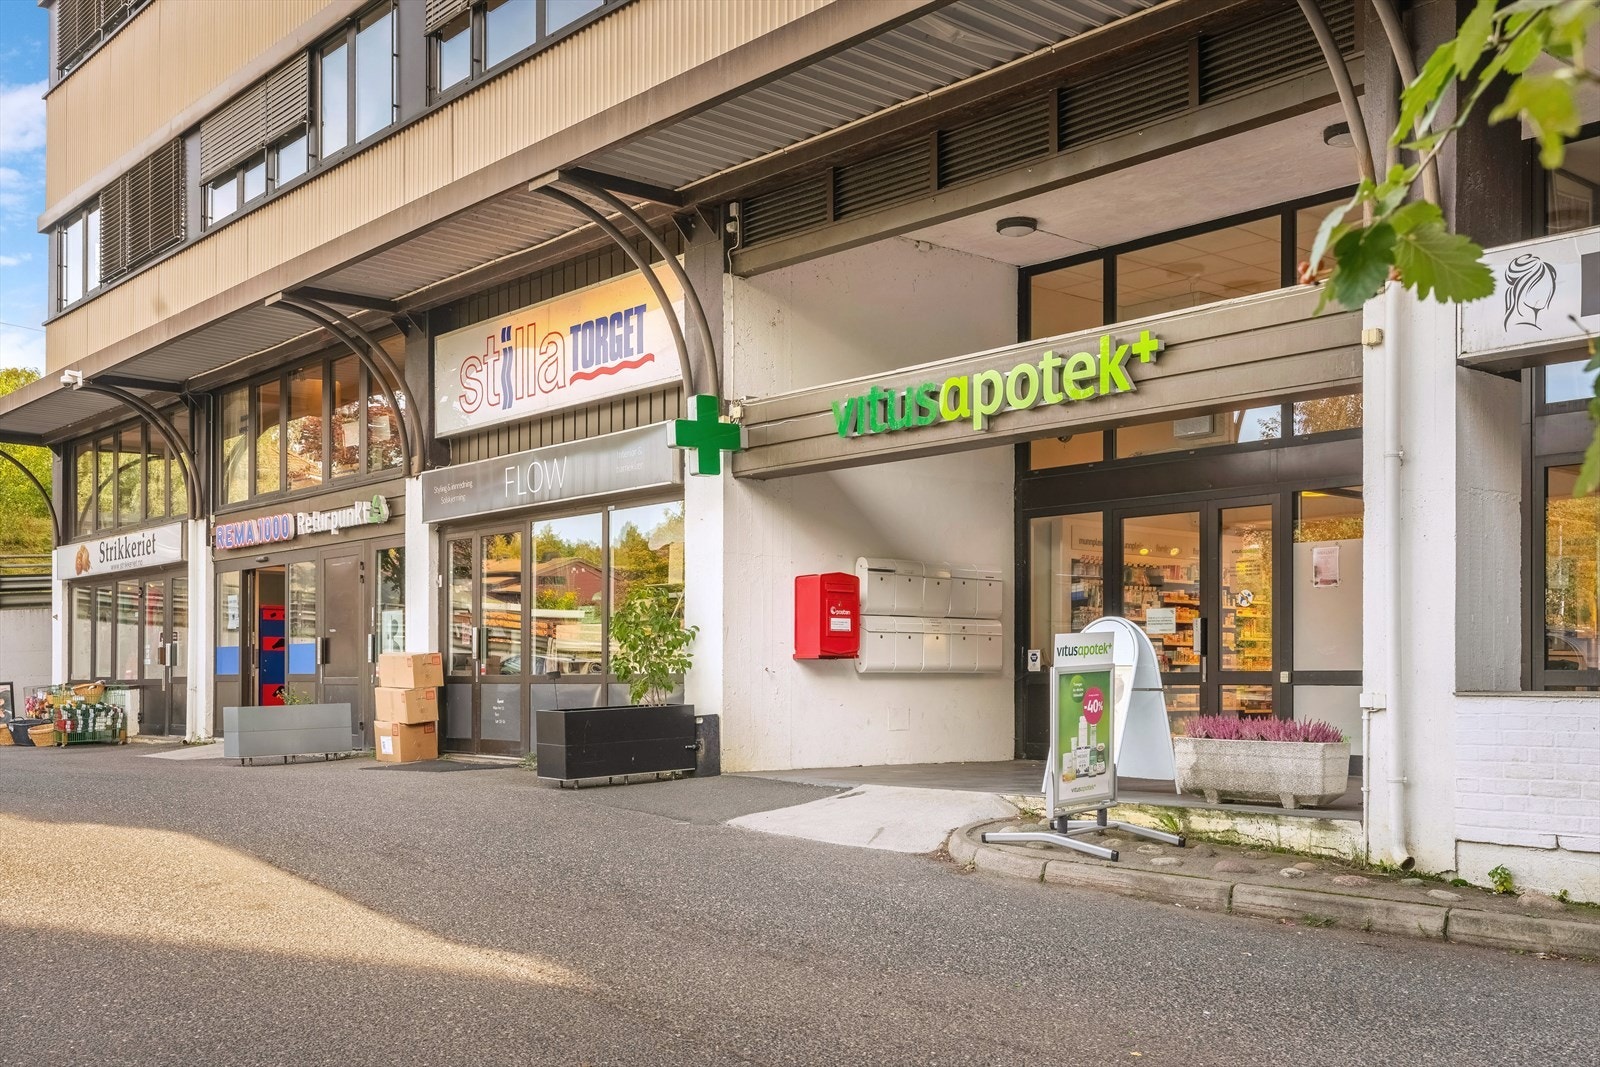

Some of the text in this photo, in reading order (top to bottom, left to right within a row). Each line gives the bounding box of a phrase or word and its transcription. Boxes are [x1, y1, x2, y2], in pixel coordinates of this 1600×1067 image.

[458, 303, 648, 415] stilla TORGET
[505, 456, 568, 498] FLOW
[99, 533, 157, 564] Strikkeriet
[216, 513, 295, 549] REMA 1000
